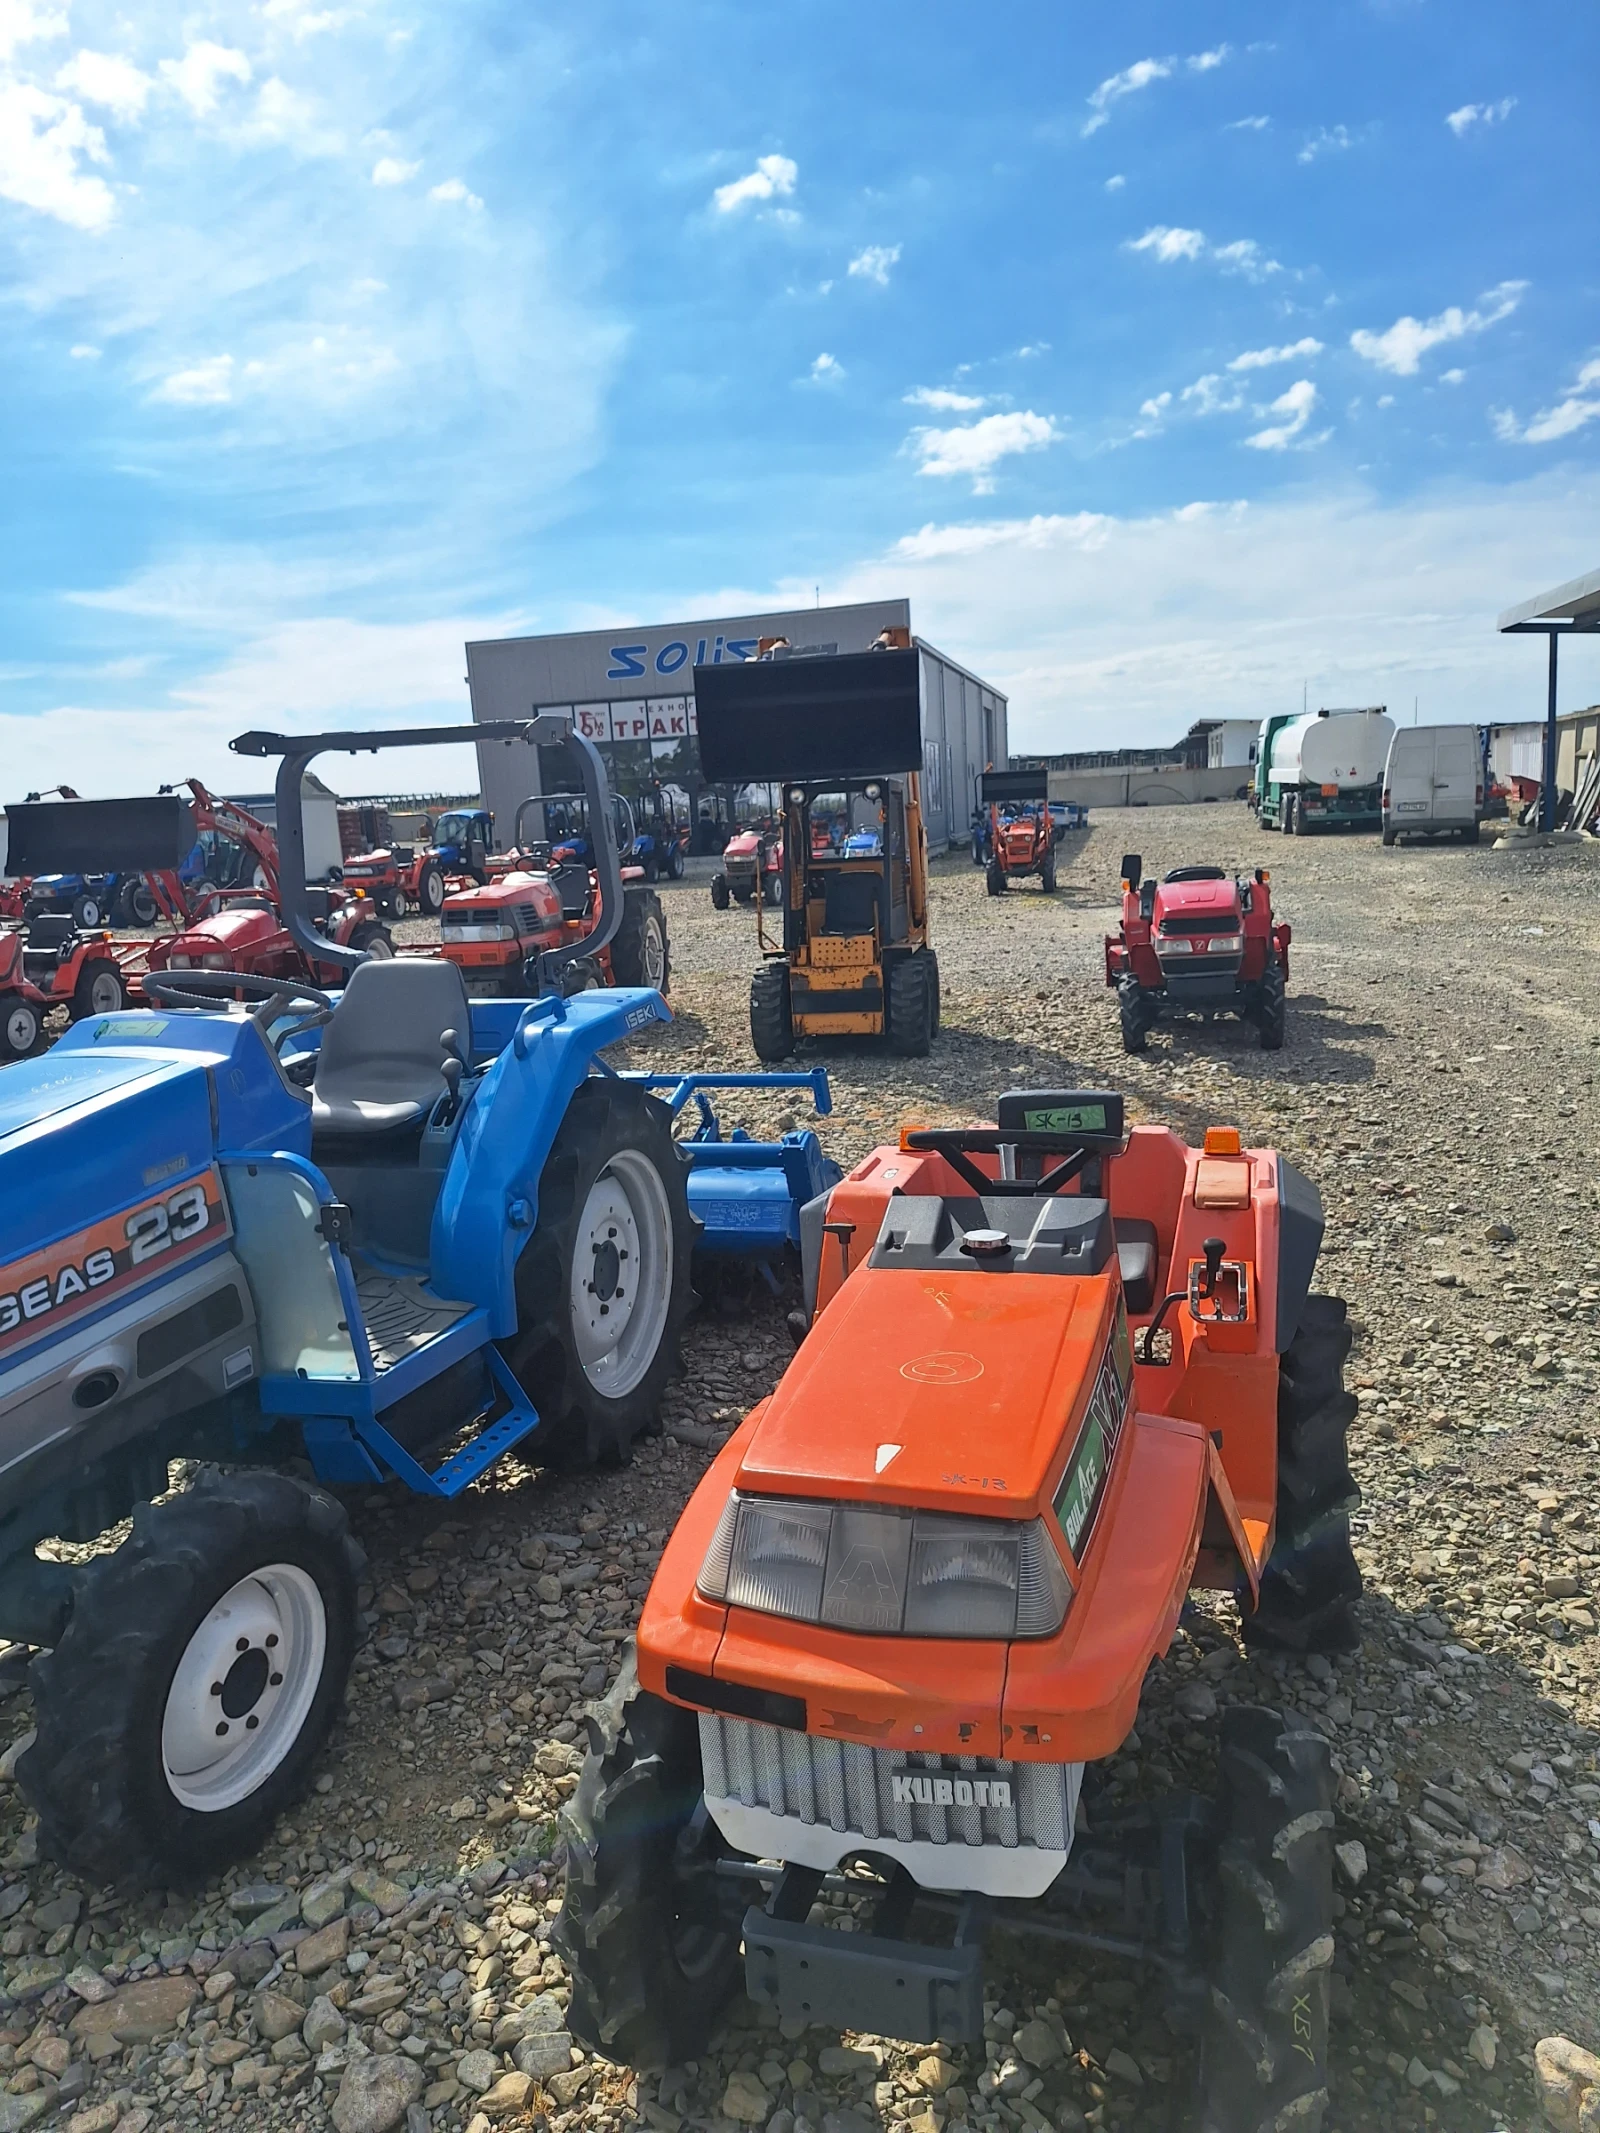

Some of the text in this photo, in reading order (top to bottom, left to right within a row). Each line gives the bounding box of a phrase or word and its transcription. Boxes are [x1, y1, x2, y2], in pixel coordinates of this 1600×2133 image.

[624, 1003, 656, 1029] ISEKI
[126, 1185, 209, 1265] 23
[892, 1776, 1011, 1808] KUBOTA
